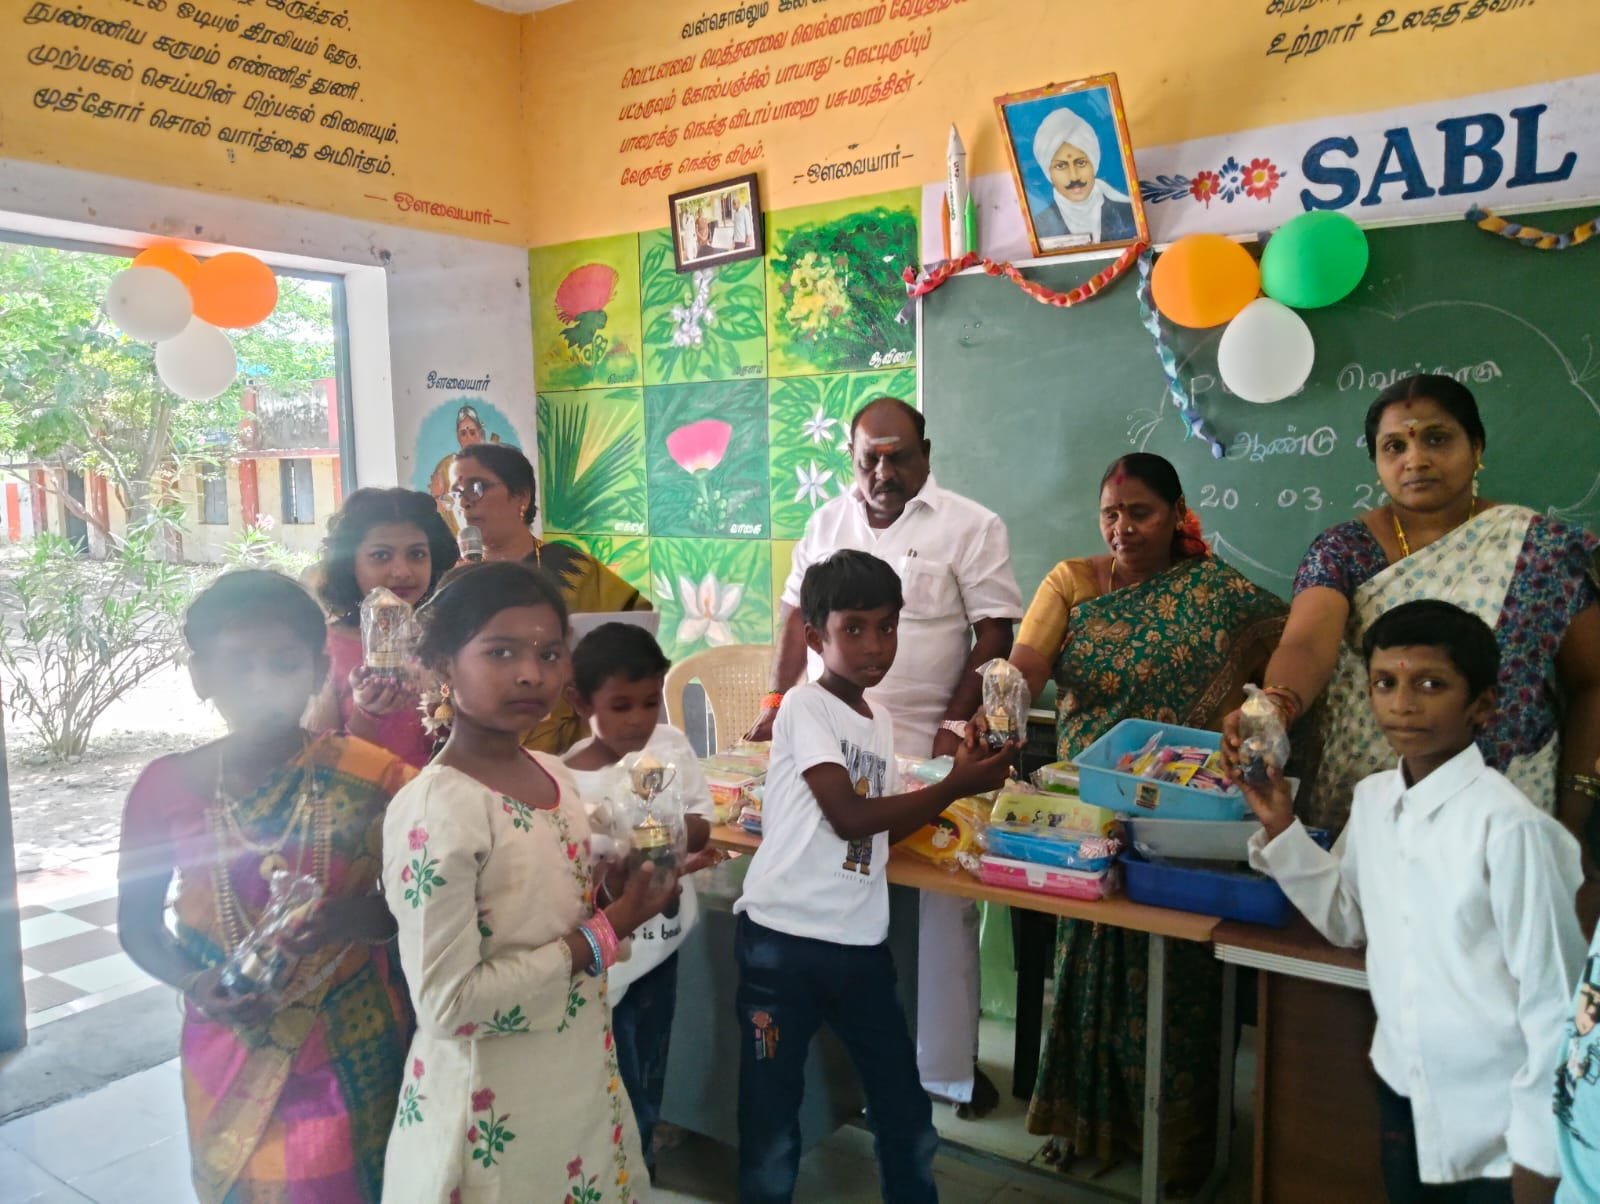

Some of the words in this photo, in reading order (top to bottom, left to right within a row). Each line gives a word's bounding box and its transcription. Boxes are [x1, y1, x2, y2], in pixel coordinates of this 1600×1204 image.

[23, 2, 148, 45] நுண்ணிய
[152, 35, 221, 65] கருமம்
[227, 54, 312, 90] எண்ணித்
[240, 22, 319, 56] திரவியம்
[1266, 13, 1364, 63] உற்றார்
[27, 44, 134, 82] முற்பகல்
[141, 67, 236, 105] செய்யின்
[243, 90, 316, 124] பிற்பகல்
[33, 86, 146, 125] மூத்தோர்
[149, 108, 212, 137] சொல்
[217, 127, 309, 159] வார்த்தை
[313, 145, 395, 177] அமிர்தம்.
[1300, 103, 1577, 211] SABL
[1225, 425, 1337, 463] ஆண்டு
[643, 927, 654, 940] is
